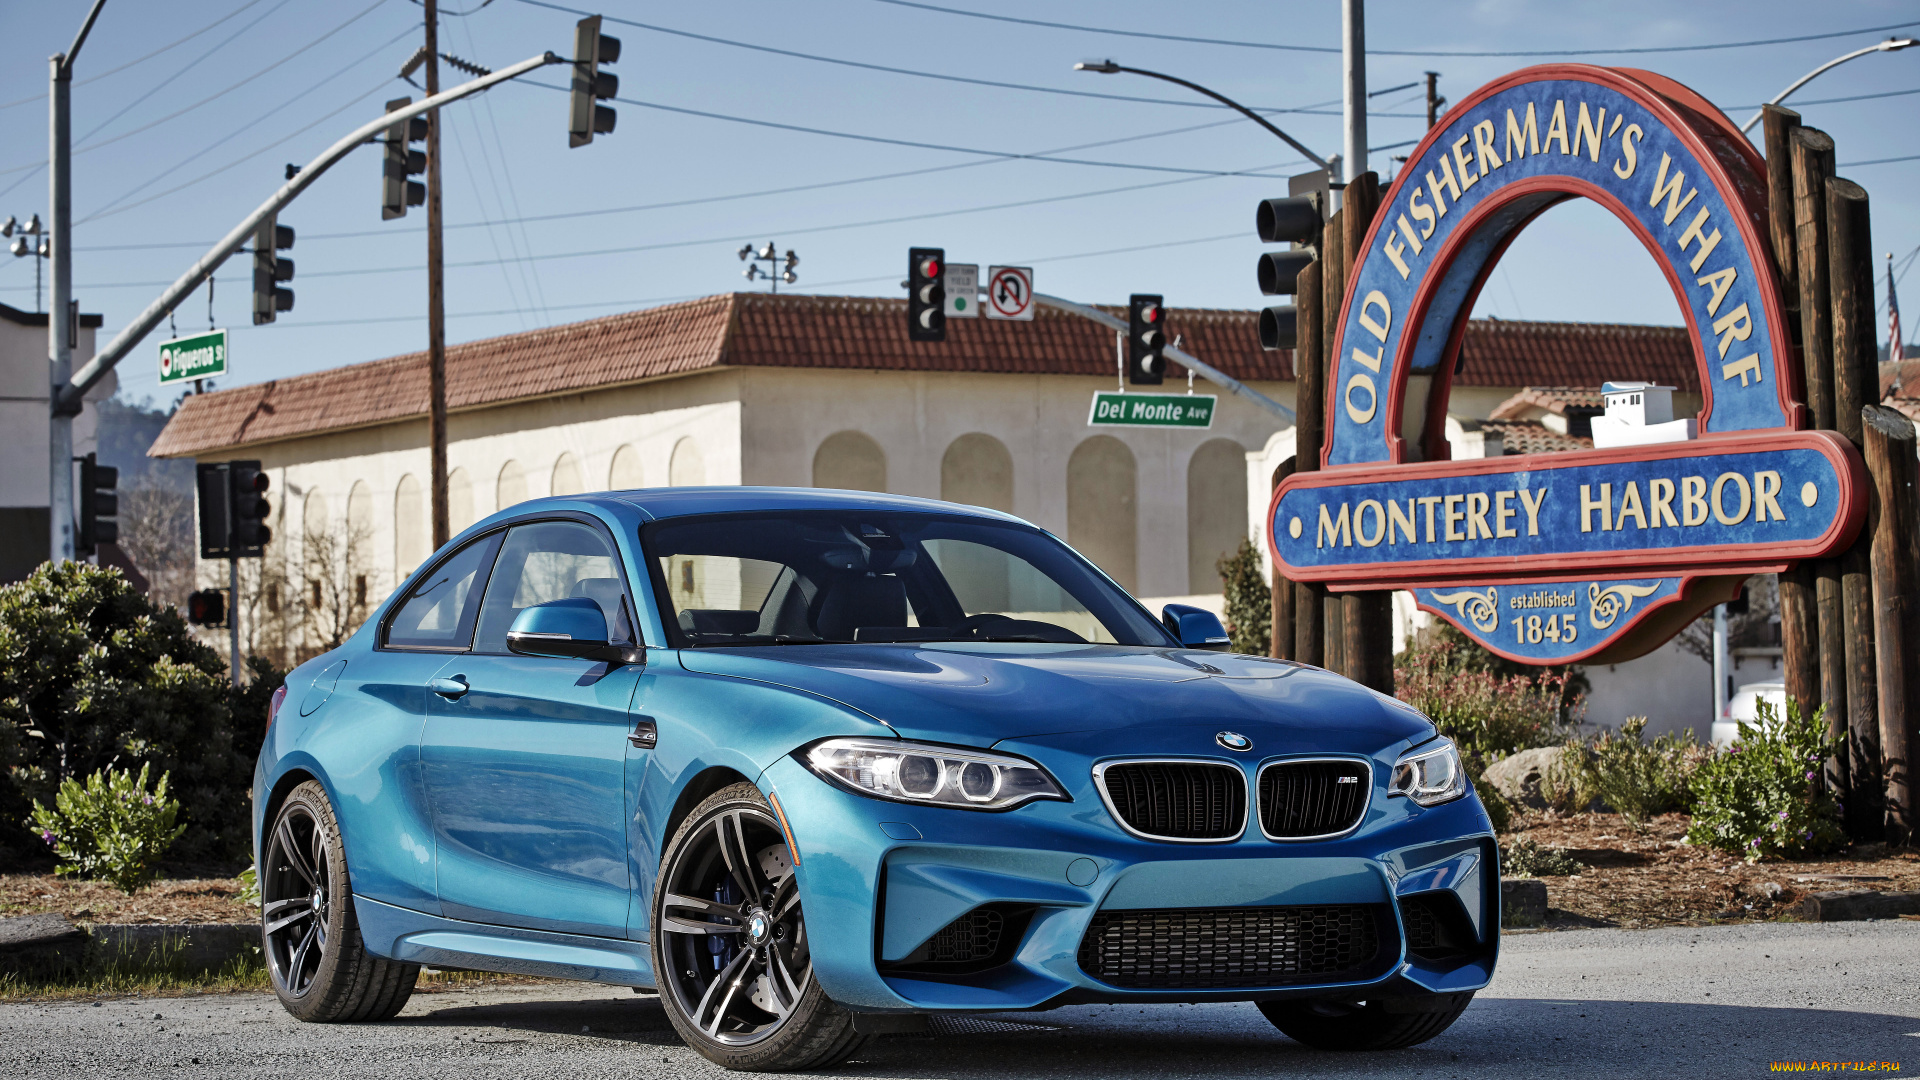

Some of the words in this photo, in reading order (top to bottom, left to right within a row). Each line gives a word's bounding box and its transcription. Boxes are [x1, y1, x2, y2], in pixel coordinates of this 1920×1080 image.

[1345, 290, 1392, 424] OLD
[1383, 99, 1644, 281] FISHERMAN'S
[1649, 151, 1762, 387] WHARF
[951, 277, 971, 286] YIELD
[173, 346, 214, 377] Figueroa
[1098, 401, 1126, 418] Del
[1132, 402, 1183, 420] Monte
[1187, 407, 1208, 419] Ave
[1316, 488, 1547, 548] MONTEREY
[1580, 470, 1786, 532] HARBOR
[1510, 590, 1576, 609] established
[1511, 613, 1577, 644] 1845
